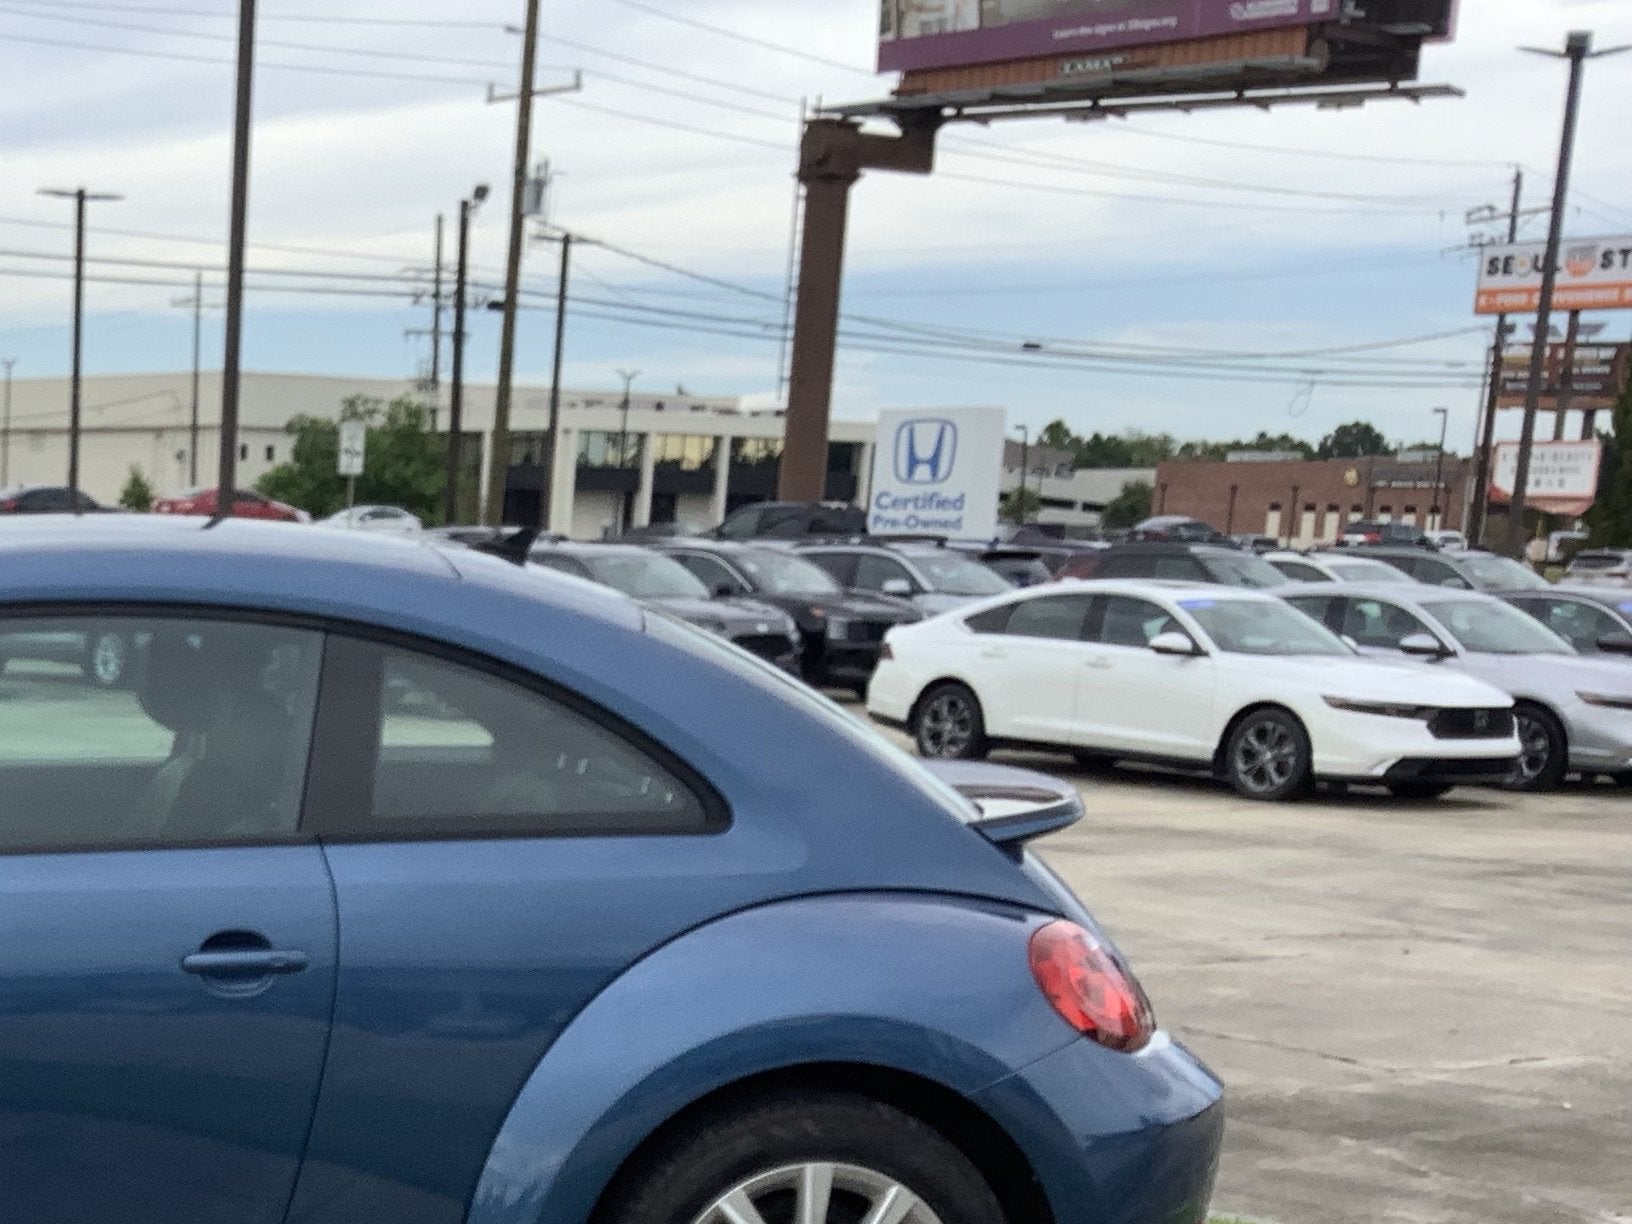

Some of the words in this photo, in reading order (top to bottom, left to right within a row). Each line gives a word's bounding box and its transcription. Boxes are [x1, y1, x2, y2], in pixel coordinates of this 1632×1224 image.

[1487, 252, 1561, 278] SEOU
[875, 491, 965, 511] Certified
[873, 514, 962, 530] Pre-Owned
